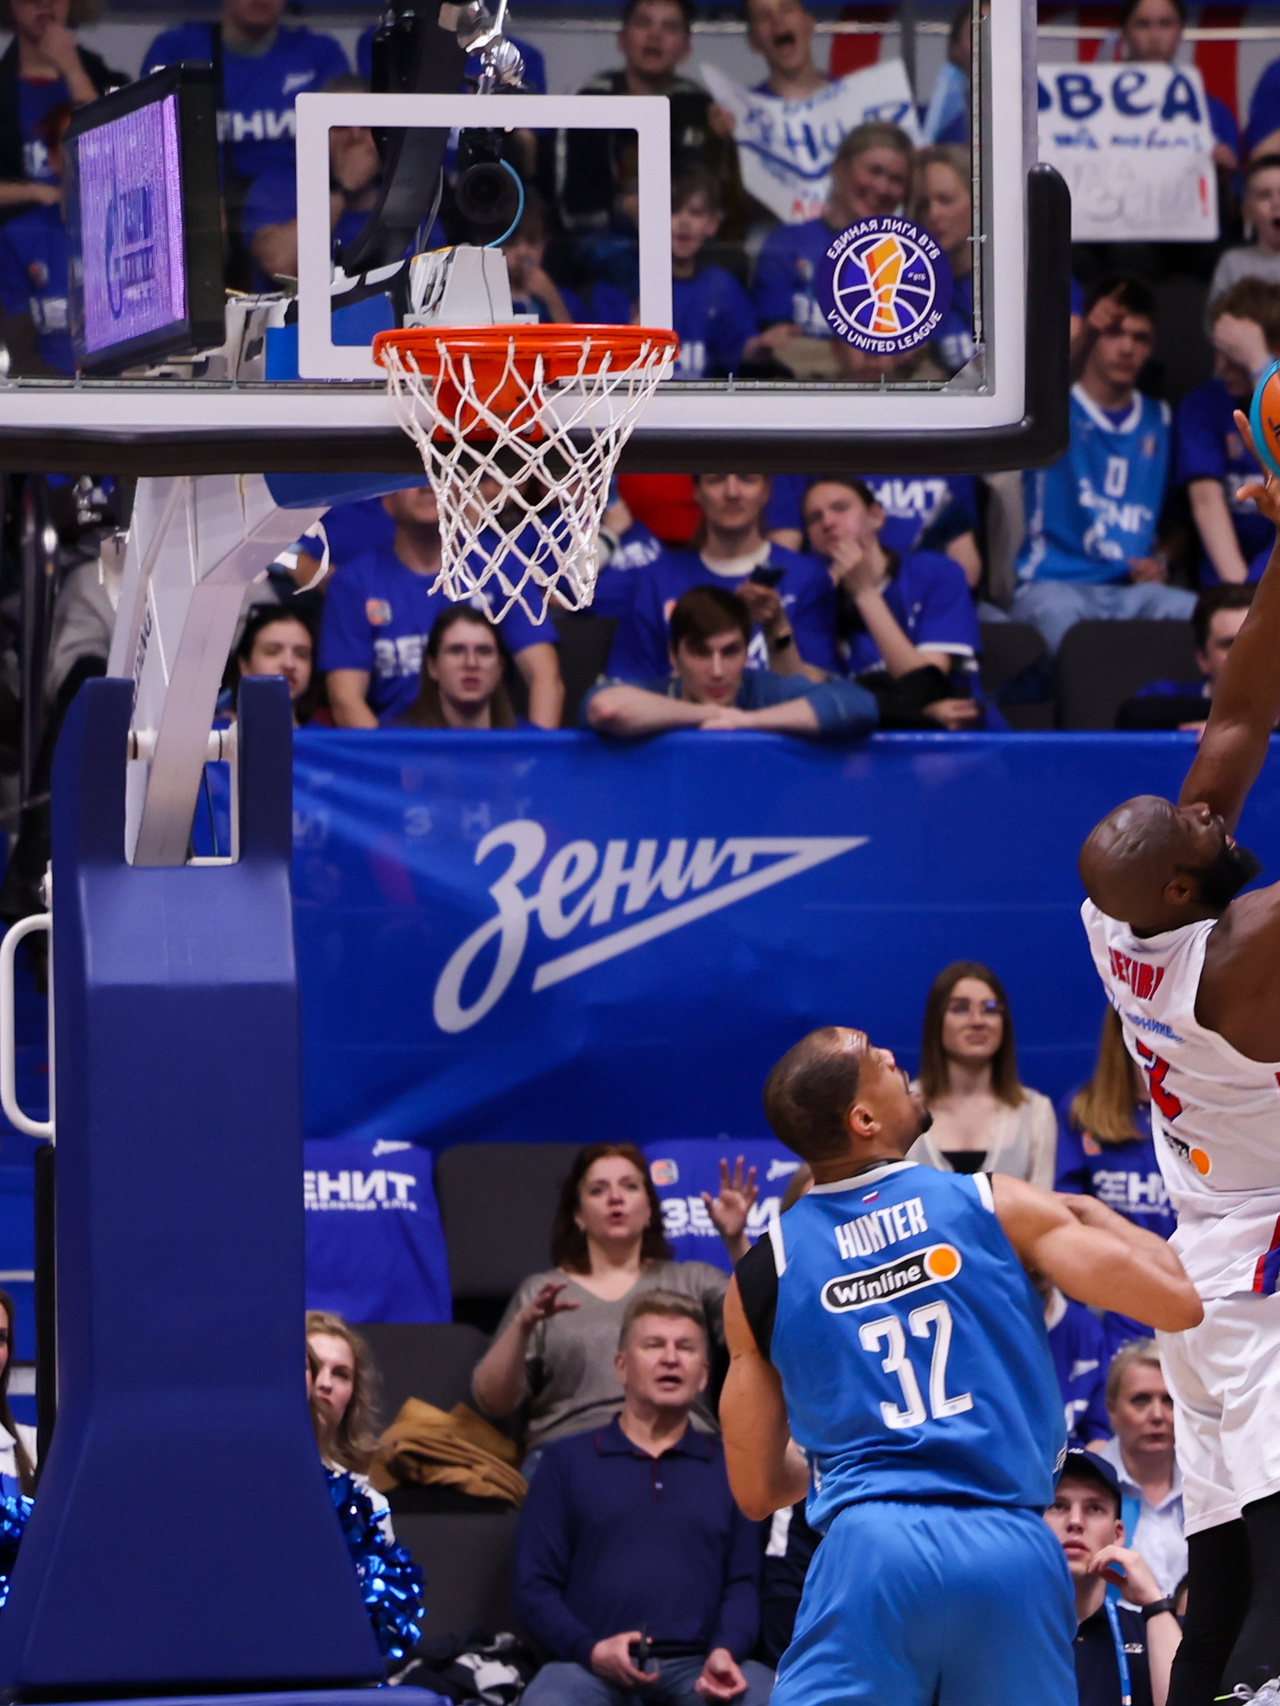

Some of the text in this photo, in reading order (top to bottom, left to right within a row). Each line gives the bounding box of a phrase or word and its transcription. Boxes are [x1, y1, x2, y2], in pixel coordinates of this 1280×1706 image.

[826, 218, 941, 260] ЕДИНАЯ ЛИГА ВТБ
[826, 309, 859, 335] VTB
[847, 330, 896, 352] UNITED
[897, 310, 943, 351] LEAGUE
[434, 819, 869, 1034] Зенит
[834, 1196, 929, 1260] HUNTER
[833, 1264, 922, 1304] Winline
[858, 1300, 974, 1430] 32
